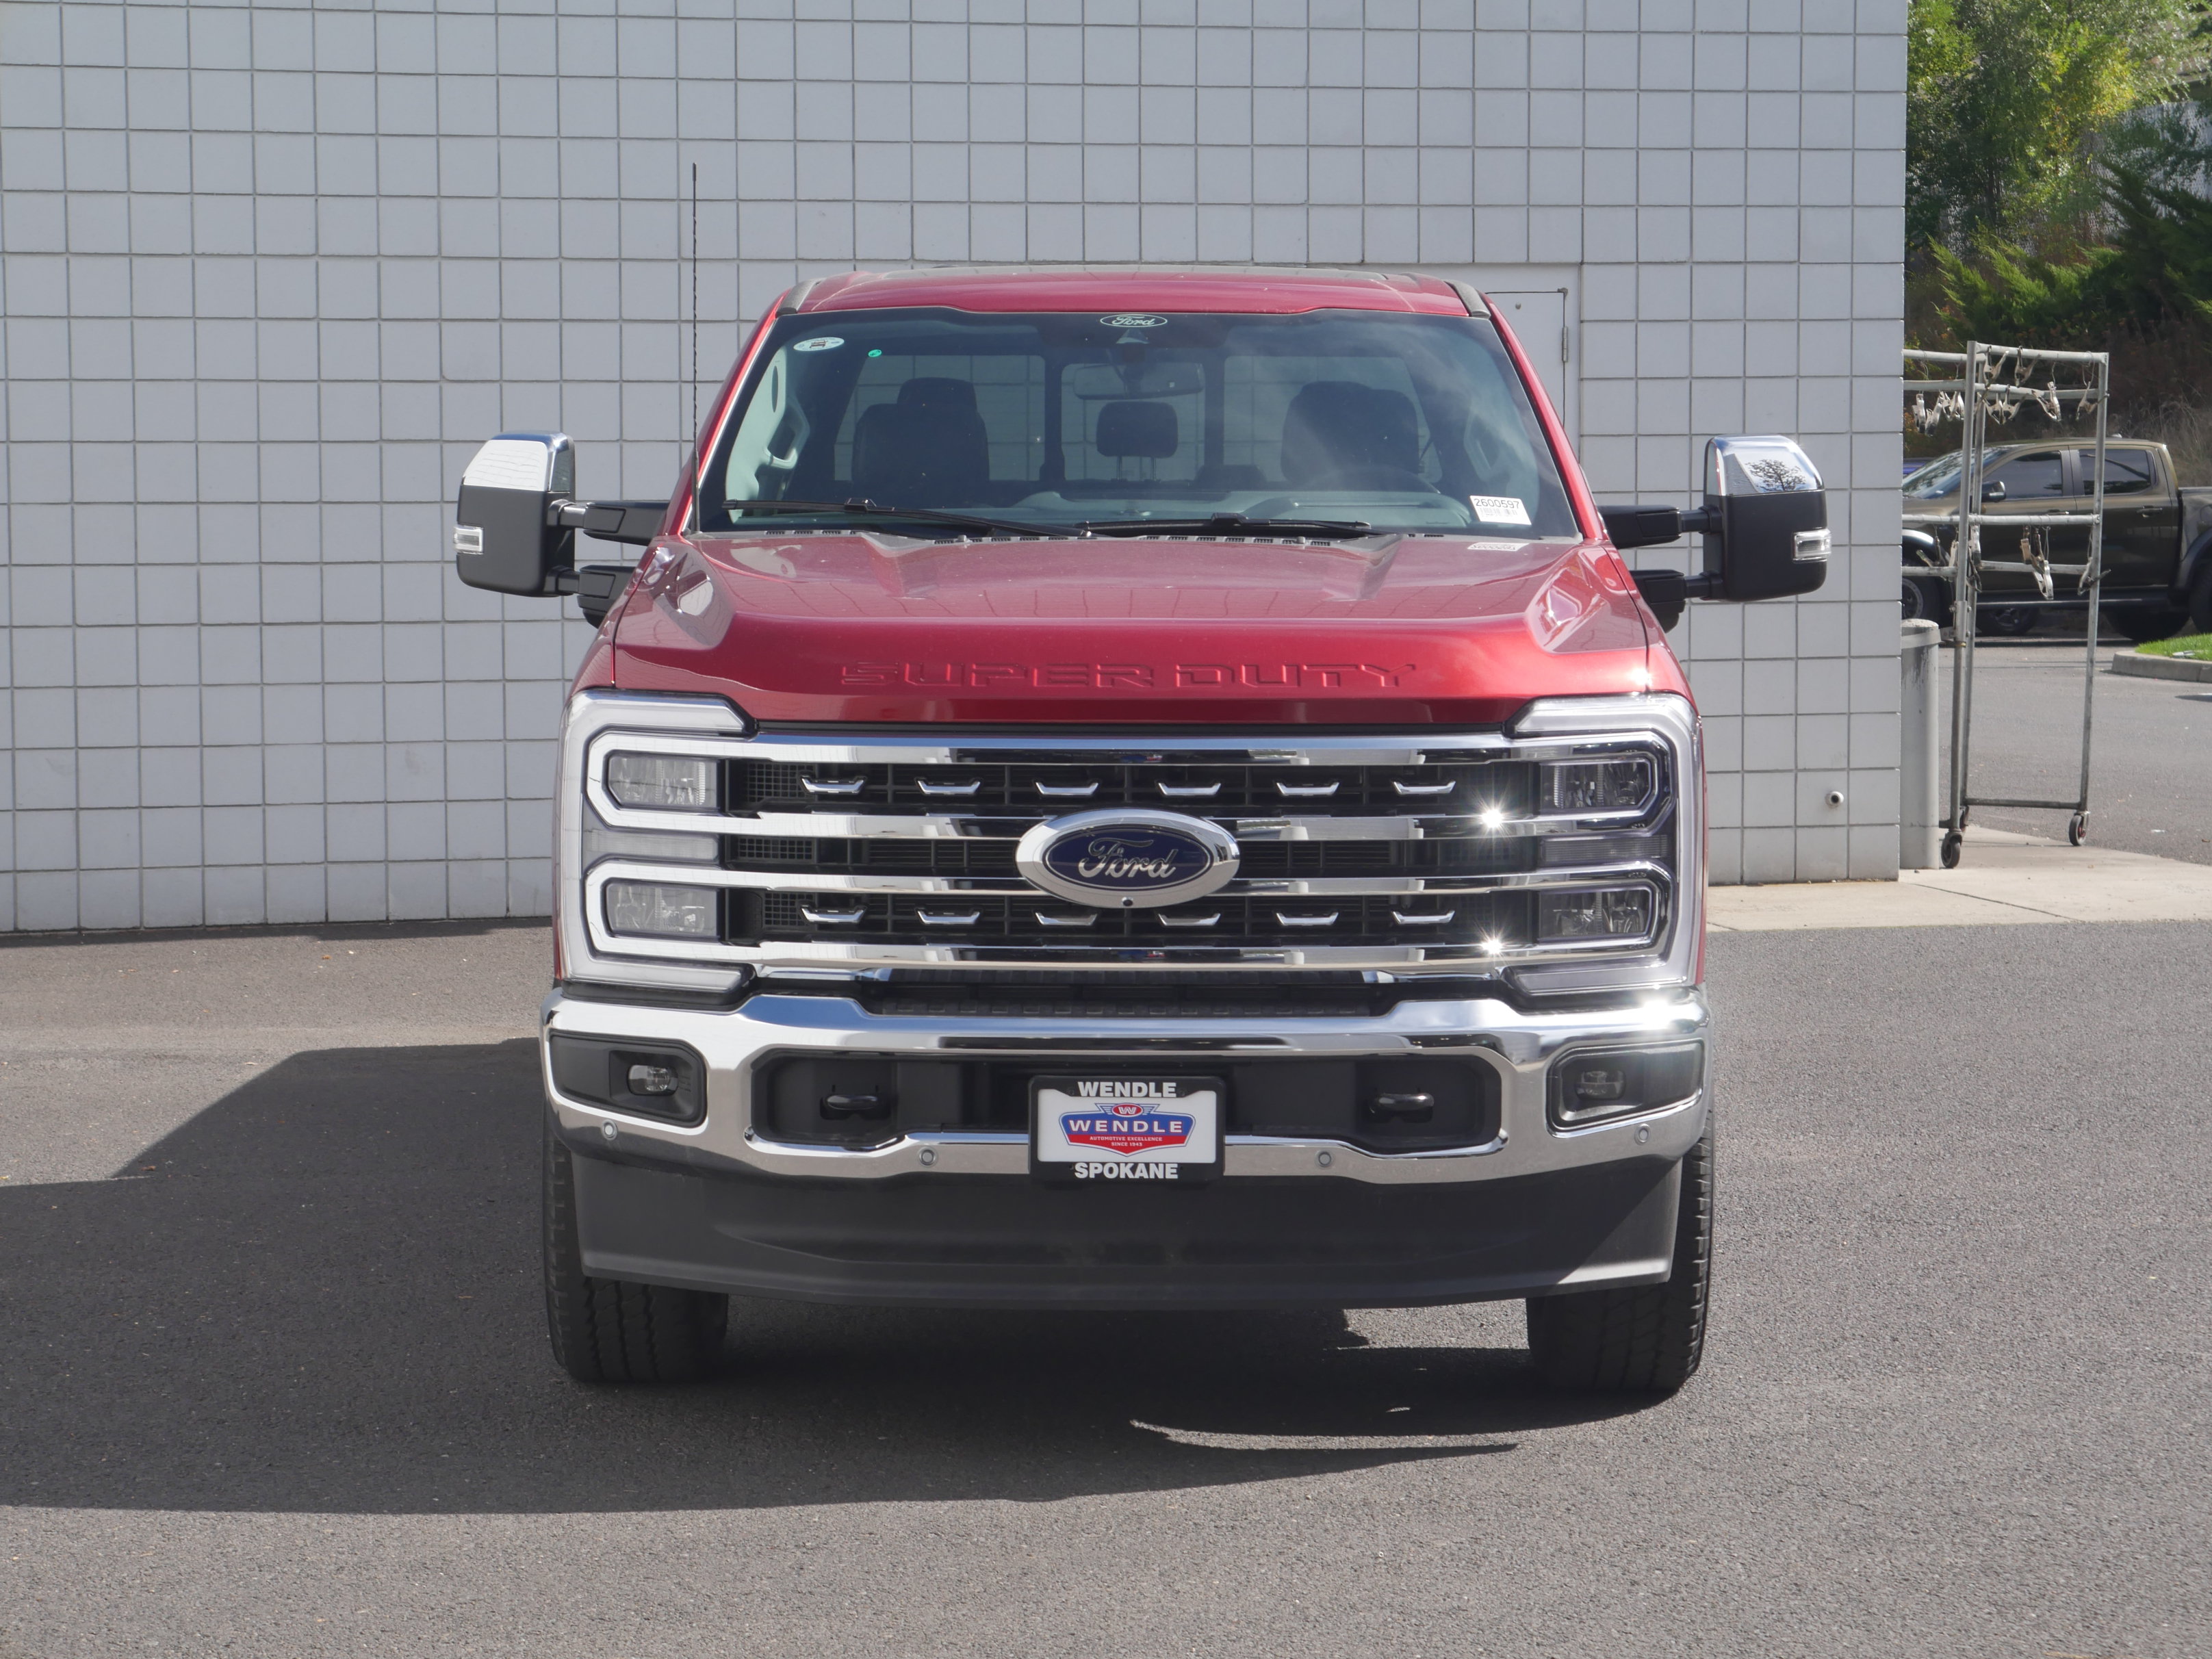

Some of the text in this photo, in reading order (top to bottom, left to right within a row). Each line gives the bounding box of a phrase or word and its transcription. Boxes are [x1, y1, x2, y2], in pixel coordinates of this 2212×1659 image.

[1111, 316, 1156, 325] Ford
[1474, 498, 1519, 509] 2600597
[840, 661, 1416, 688] SUPER DUTY
[1078, 837, 1179, 878] Ford
[1077, 1081, 1177, 1098] WENDLE
[1068, 1120, 1183, 1133] WENDLE
[1074, 1162, 1179, 1179] SPOKANE
